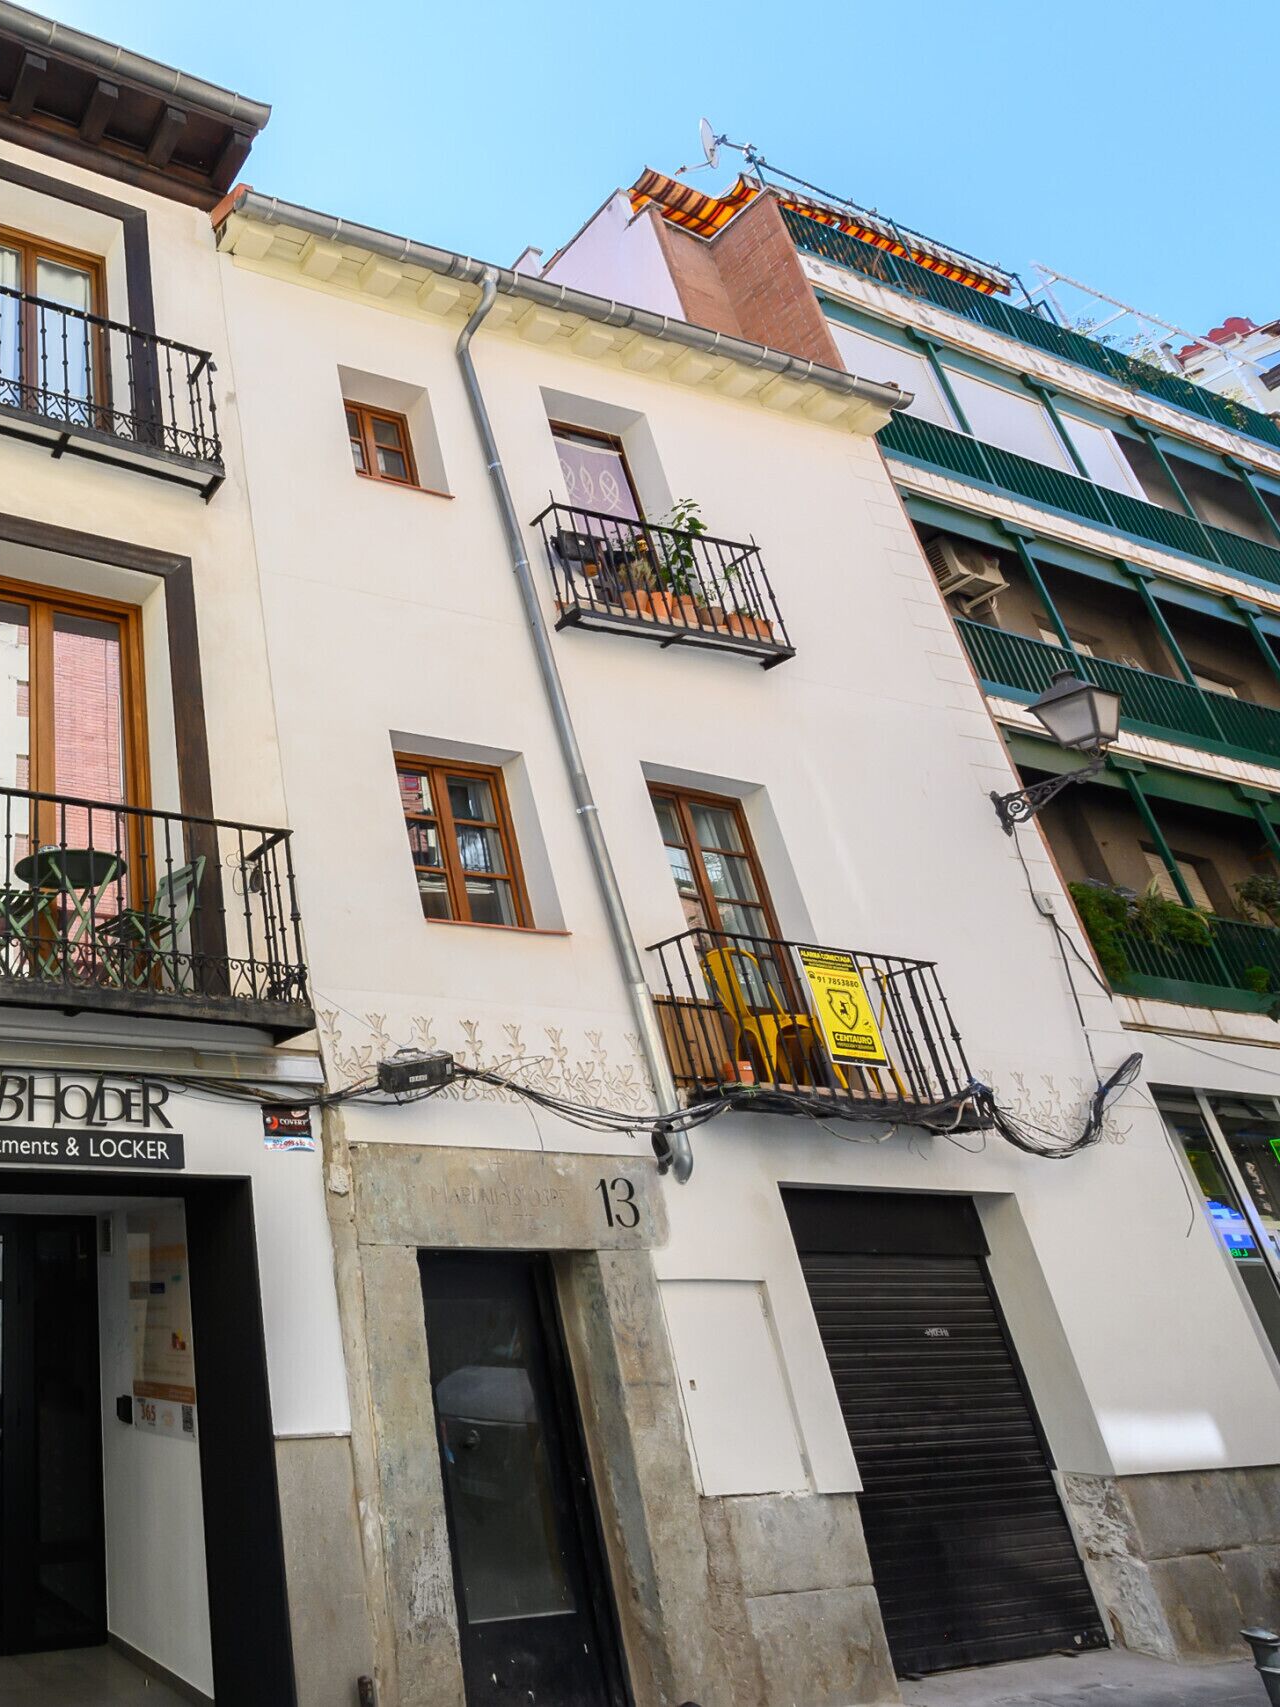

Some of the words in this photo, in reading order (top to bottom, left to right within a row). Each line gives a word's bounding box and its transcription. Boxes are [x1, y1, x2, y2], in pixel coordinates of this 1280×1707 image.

[835, 1033, 873, 1045] CENTAURO
[279, 1118, 307, 1126] COVERT
[65, 1136, 80, 1157] &
[89, 1138, 170, 1160] LOCKER
[595, 1177, 641, 1228] 13
